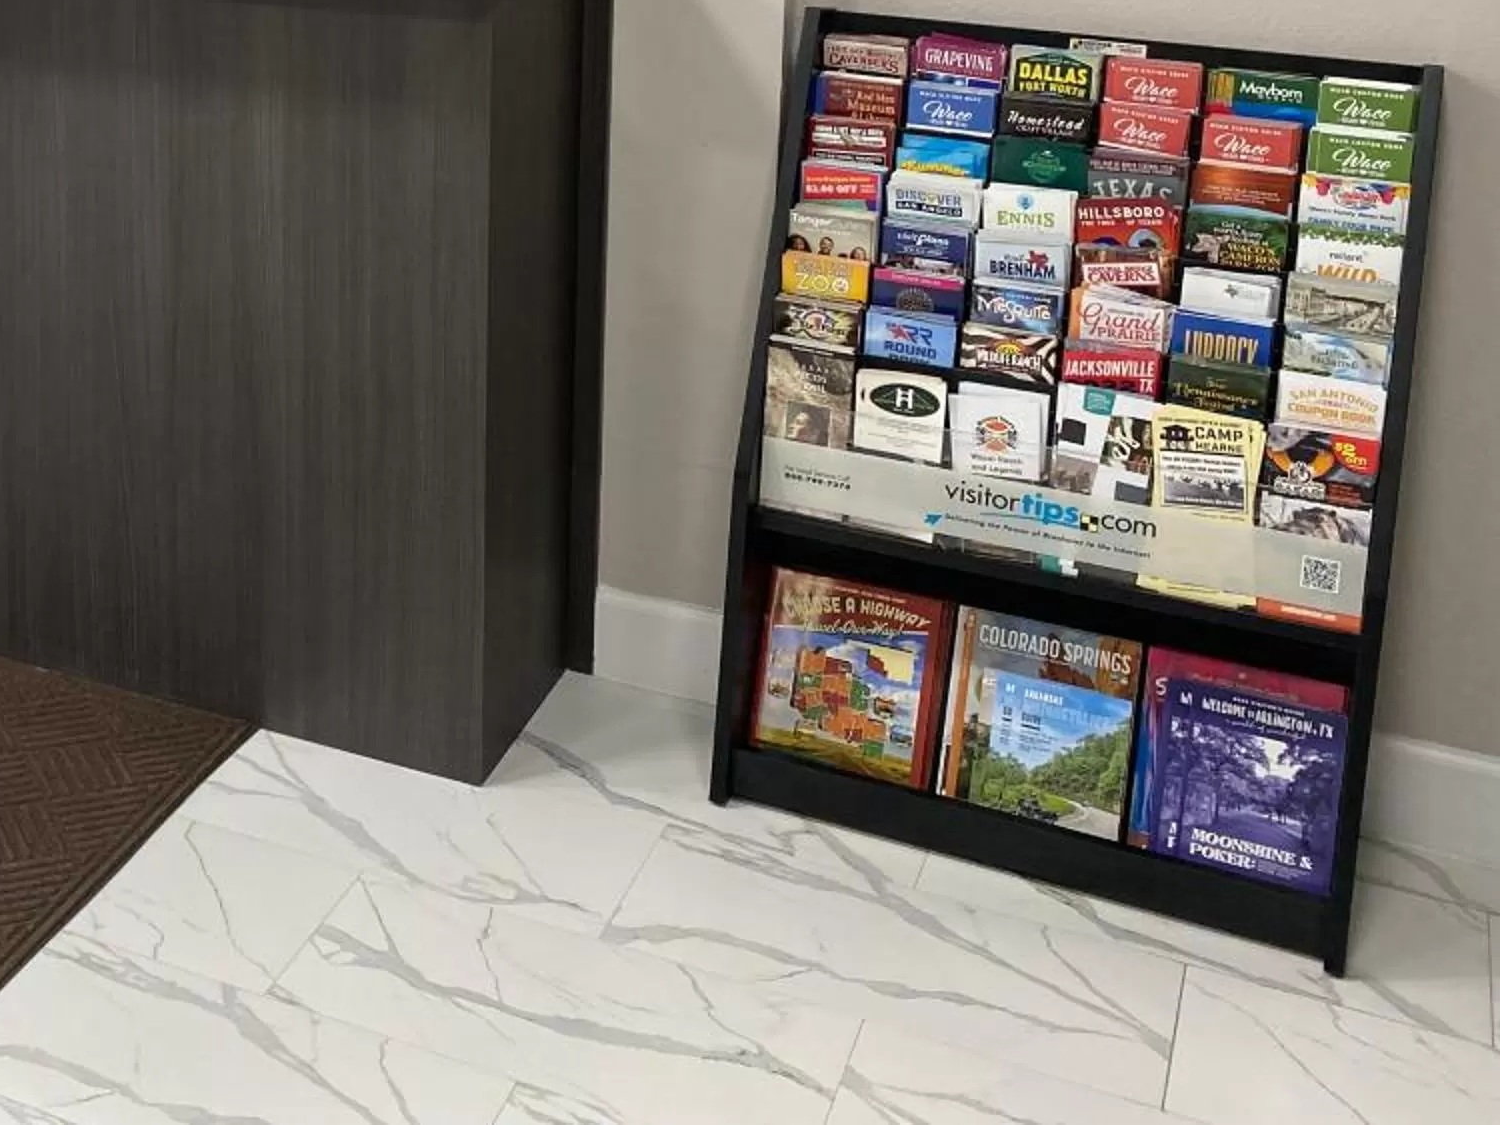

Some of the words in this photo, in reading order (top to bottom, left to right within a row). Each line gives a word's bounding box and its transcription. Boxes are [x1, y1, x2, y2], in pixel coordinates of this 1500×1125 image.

[925, 48, 994, 72] GRAPEVINE
[1019, 62, 1088, 85] DALLAS
[1019, 81, 1046, 93] FORT
[1049, 83, 1086, 98] WORTH
[1124, 76, 1179, 97] Waco
[1239, 81, 1303, 99] Mayborn
[922, 100, 974, 122] Waco
[1333, 96, 1392, 120] Waco
[1007, 110, 1085, 131] Homestead
[1113, 118, 1168, 142] Waco
[1213, 132, 1272, 155] Waco
[1331, 148, 1392, 171] Waco
[895, 188, 962, 207] DISCOVER
[996, 210, 1056, 228] ENNIS
[1078, 206, 1165, 220] HILLSBORO
[989, 260, 1056, 280] BRENHAM
[1088, 272, 1157, 283] CAVERNS
[795, 272, 849, 293] ZOO
[977, 295, 1051, 323] Mesquite
[1080, 302, 1162, 335] Grand
[1097, 326, 1161, 342] PRAIRIE
[883, 341, 937, 359] ROUND
[1065, 359, 1155, 377] JACKSONVILLE
[1139, 378, 1154, 393] TX
[1289, 389, 1318, 402] SAN
[1195, 426, 1244, 443] CAMP
[945, 480, 1157, 538] visitortips.com
[845, 596, 856, 614] A
[859, 598, 932, 628] HIGHWAY
[979, 624, 1060, 659] COLORADO
[1063, 642, 1133, 675] SPRINGS
[1202, 696, 1247, 718] WELCOME
[1319, 722, 1334, 739] TX
[1188, 842, 1257, 870] POKER:
[1190, 827, 1296, 867] MOONSHINE
[1298, 855, 1314, 870] &
